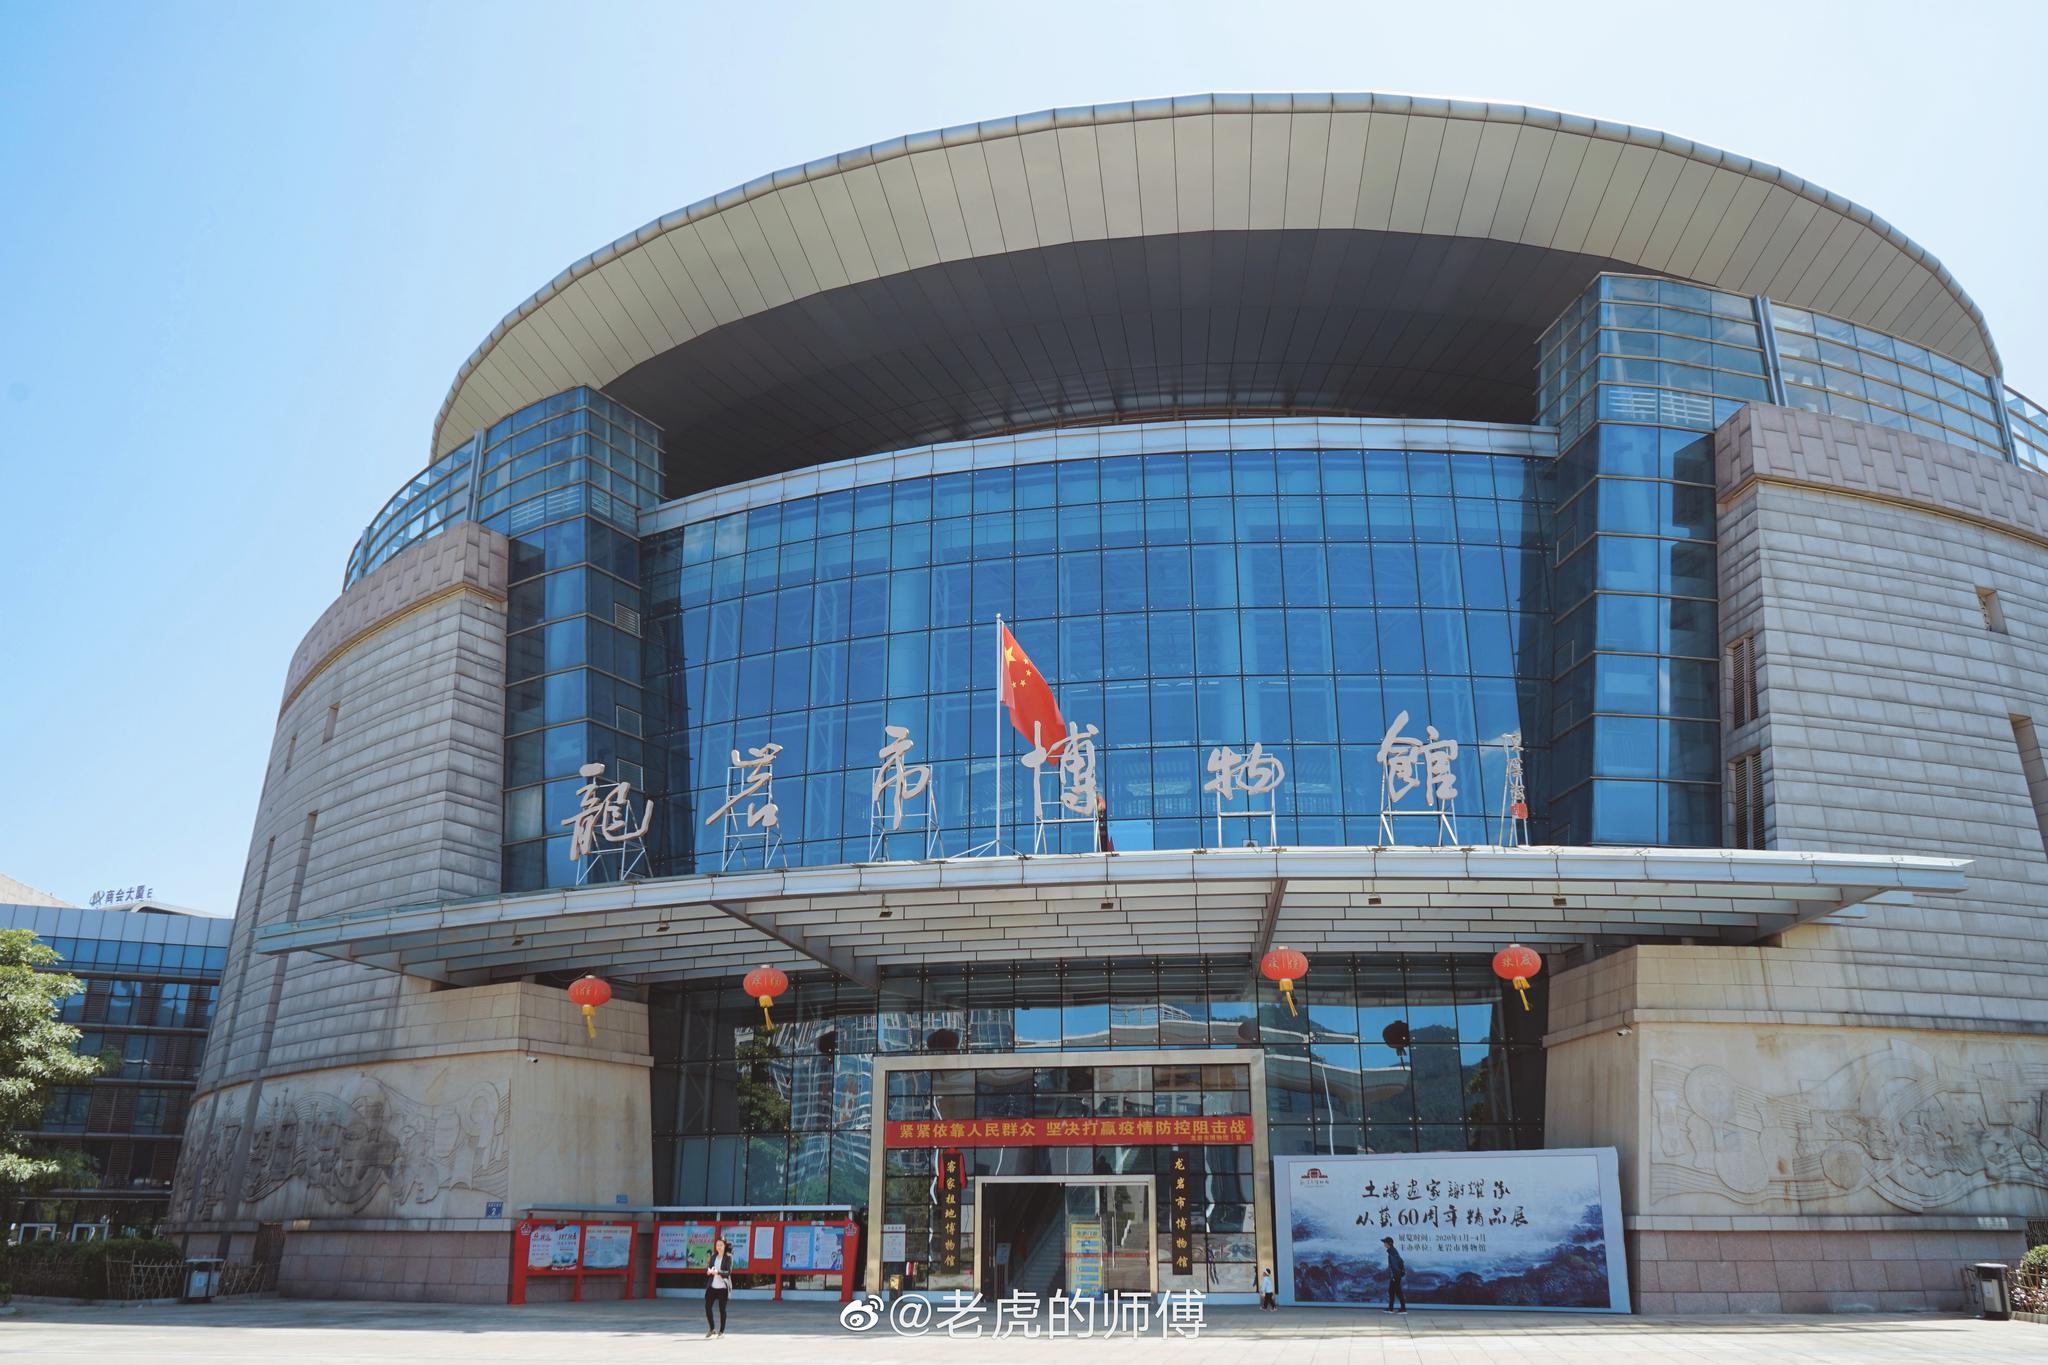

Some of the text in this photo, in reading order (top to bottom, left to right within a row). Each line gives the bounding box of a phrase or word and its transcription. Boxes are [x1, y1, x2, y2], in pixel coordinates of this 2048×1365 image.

[900, 1120, 1247, 1138] 紧紧依靠人民群众 坚决打赢疫情防控阻击战
[944, 1160, 957, 1268] 客家祖地博物馆
[1174, 1158, 1188, 1268] 龙岩市博物馆
